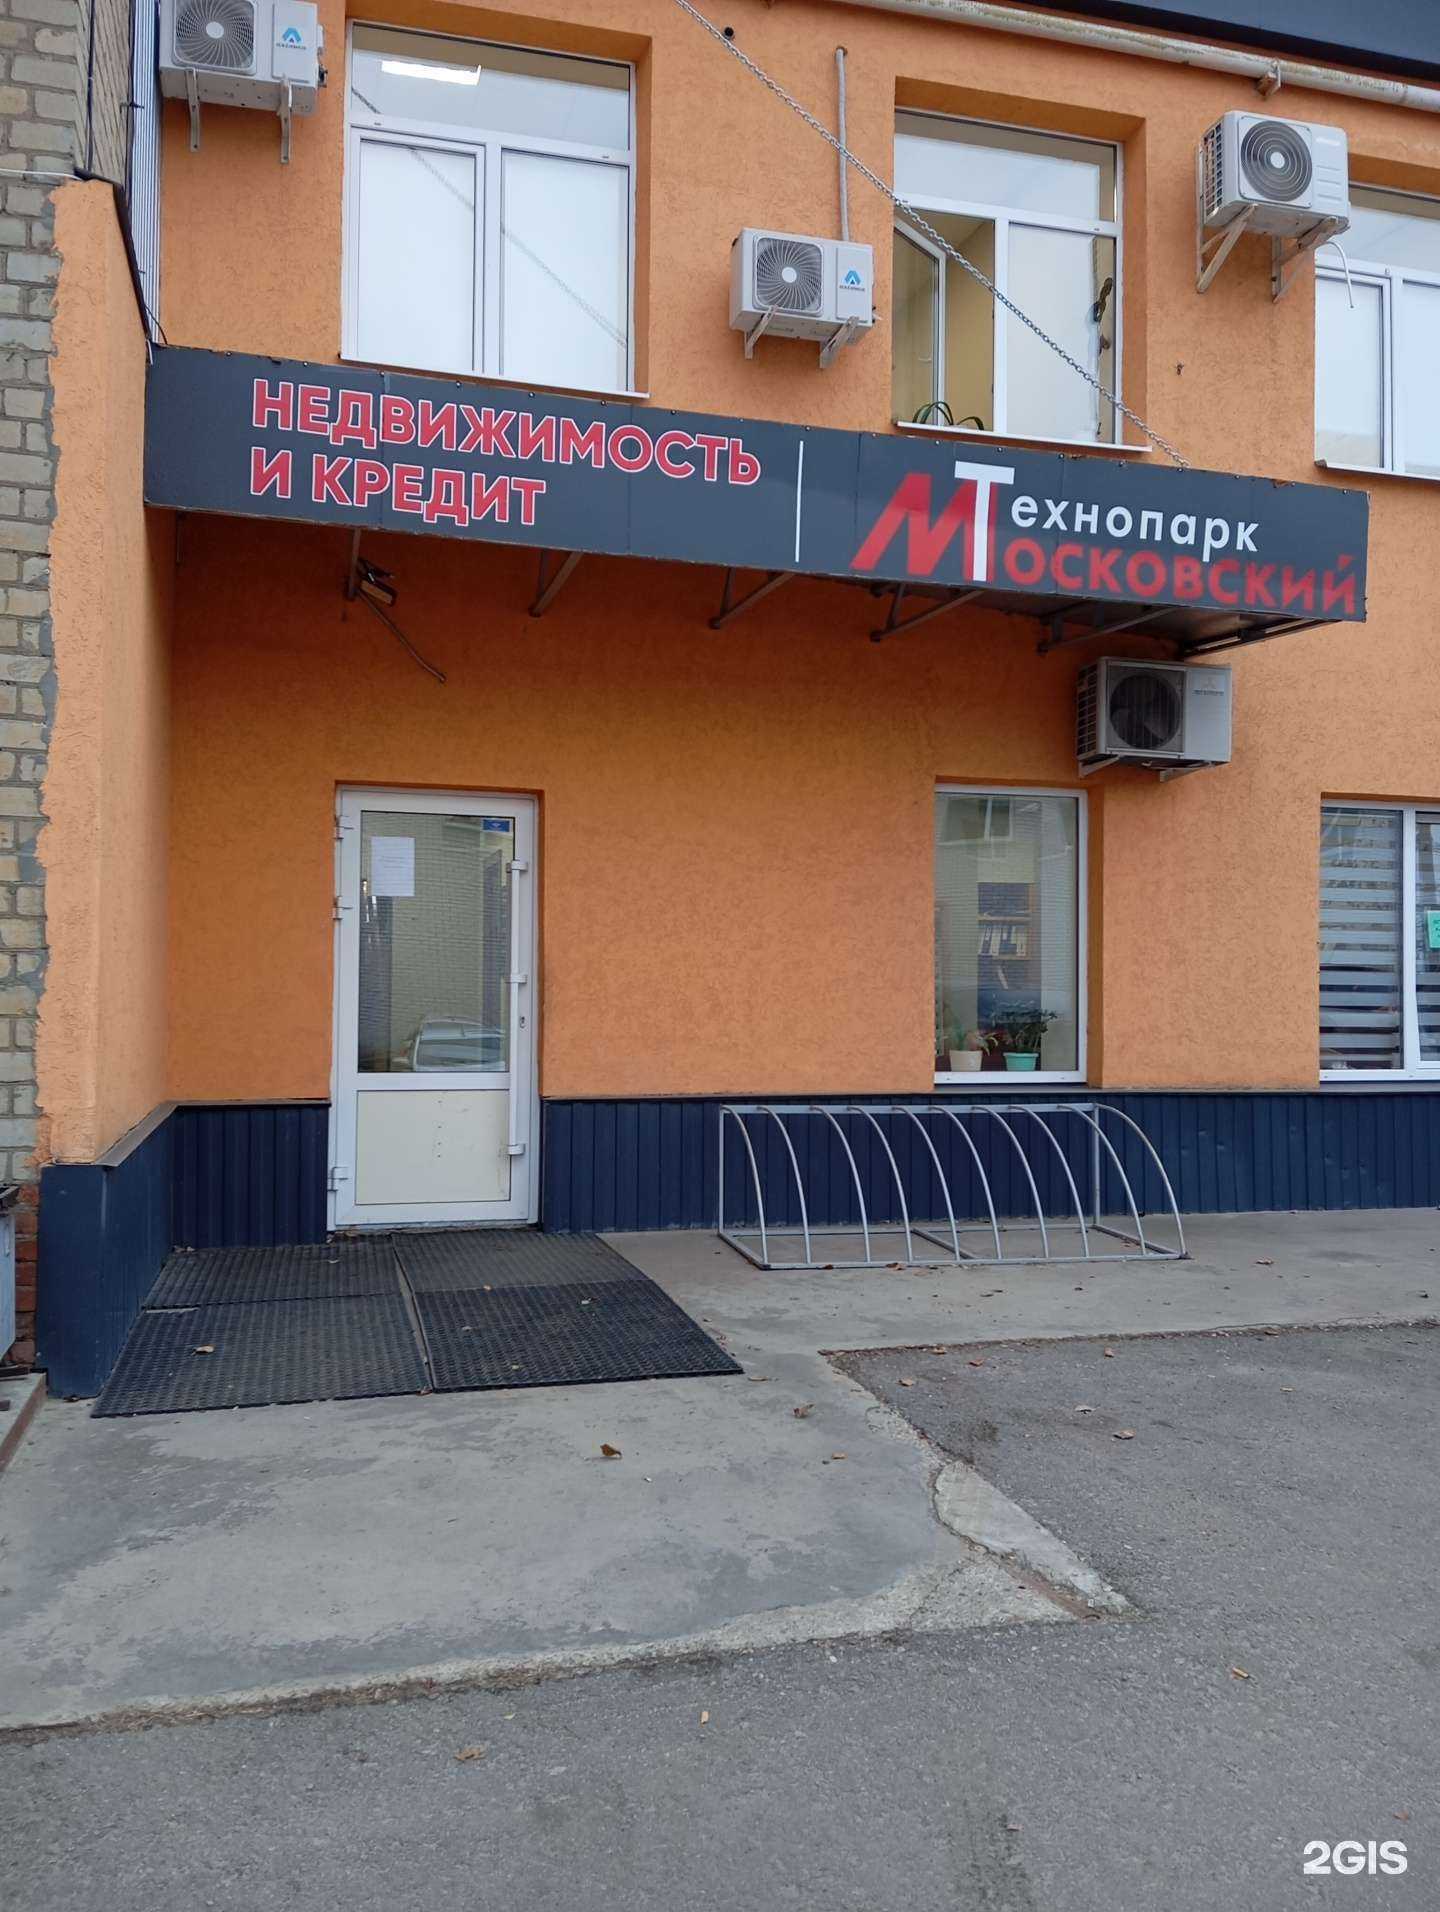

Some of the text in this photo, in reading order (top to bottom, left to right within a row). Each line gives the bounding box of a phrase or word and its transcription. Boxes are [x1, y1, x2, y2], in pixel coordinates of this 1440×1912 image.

[252, 378, 762, 485] НЕДВИЖИМОСТЬ
[250, 447, 546, 527] И КРЕДИТ
